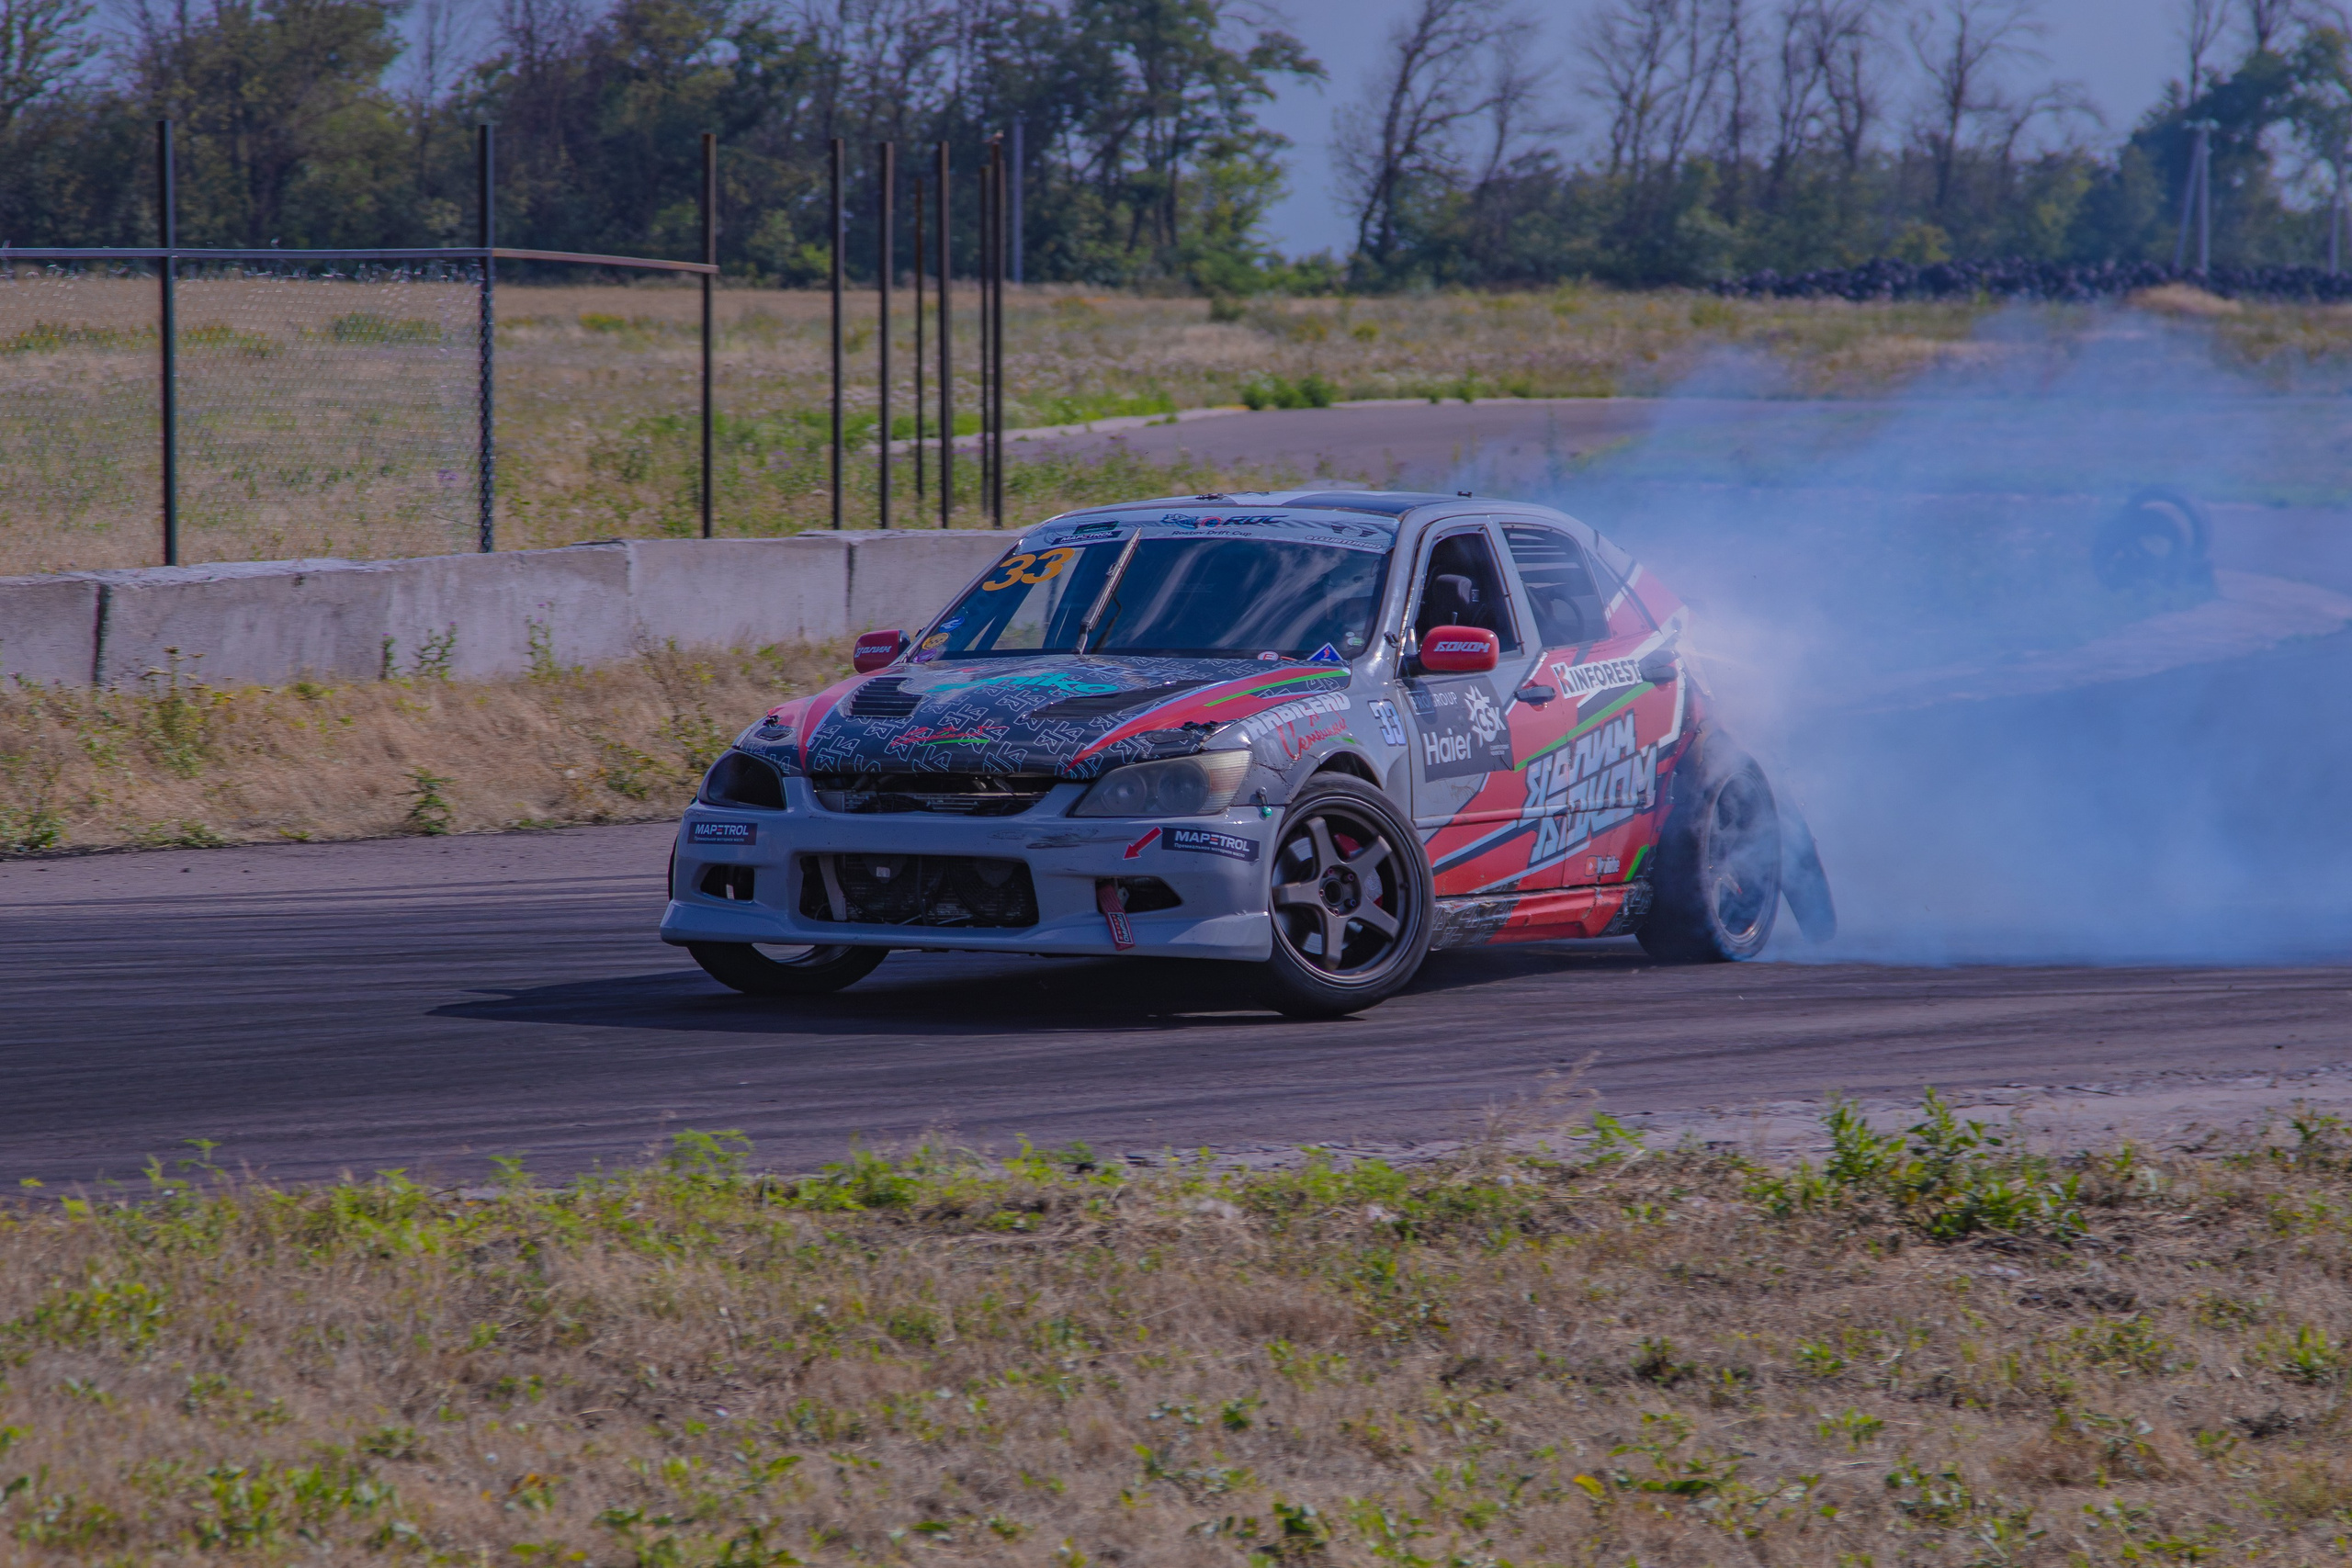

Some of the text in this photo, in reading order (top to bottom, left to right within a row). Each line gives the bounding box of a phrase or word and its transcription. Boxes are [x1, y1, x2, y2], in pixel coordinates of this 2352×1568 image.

[1060, 531, 1114, 542] MAPETROL
[982, 547, 1076, 591] 33
[1553, 659, 1642, 694] KINFOREST
[1239, 692, 1351, 740] HABILEAD
[1367, 699, 1408, 746] 33
[1422, 728, 1472, 766] Haier
[695, 823, 750, 836] MAPETROL
[1174, 830, 1250, 852] MAPETROL
